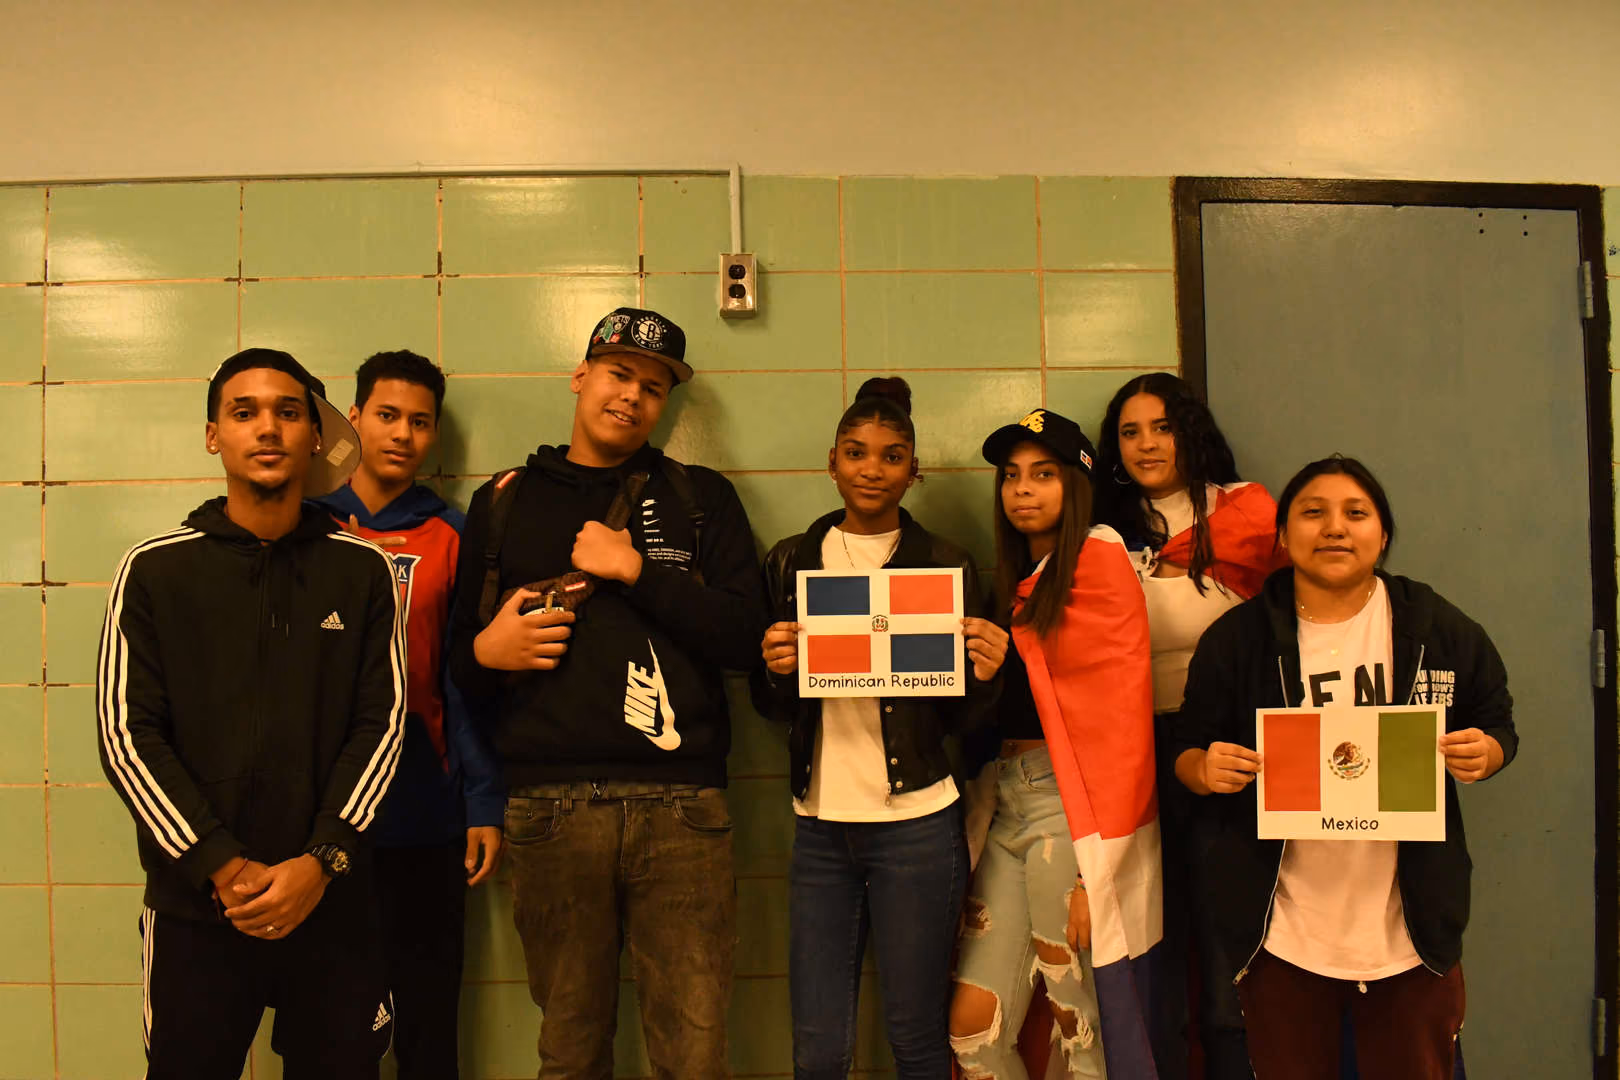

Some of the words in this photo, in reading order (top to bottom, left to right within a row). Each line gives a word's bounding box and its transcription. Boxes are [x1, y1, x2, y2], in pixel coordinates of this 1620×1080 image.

[320, 622, 345, 630] adidas
[808, 676, 886, 688] Dominican
[891, 674, 955, 689] Republic
[1321, 816, 1379, 830] Mexico
